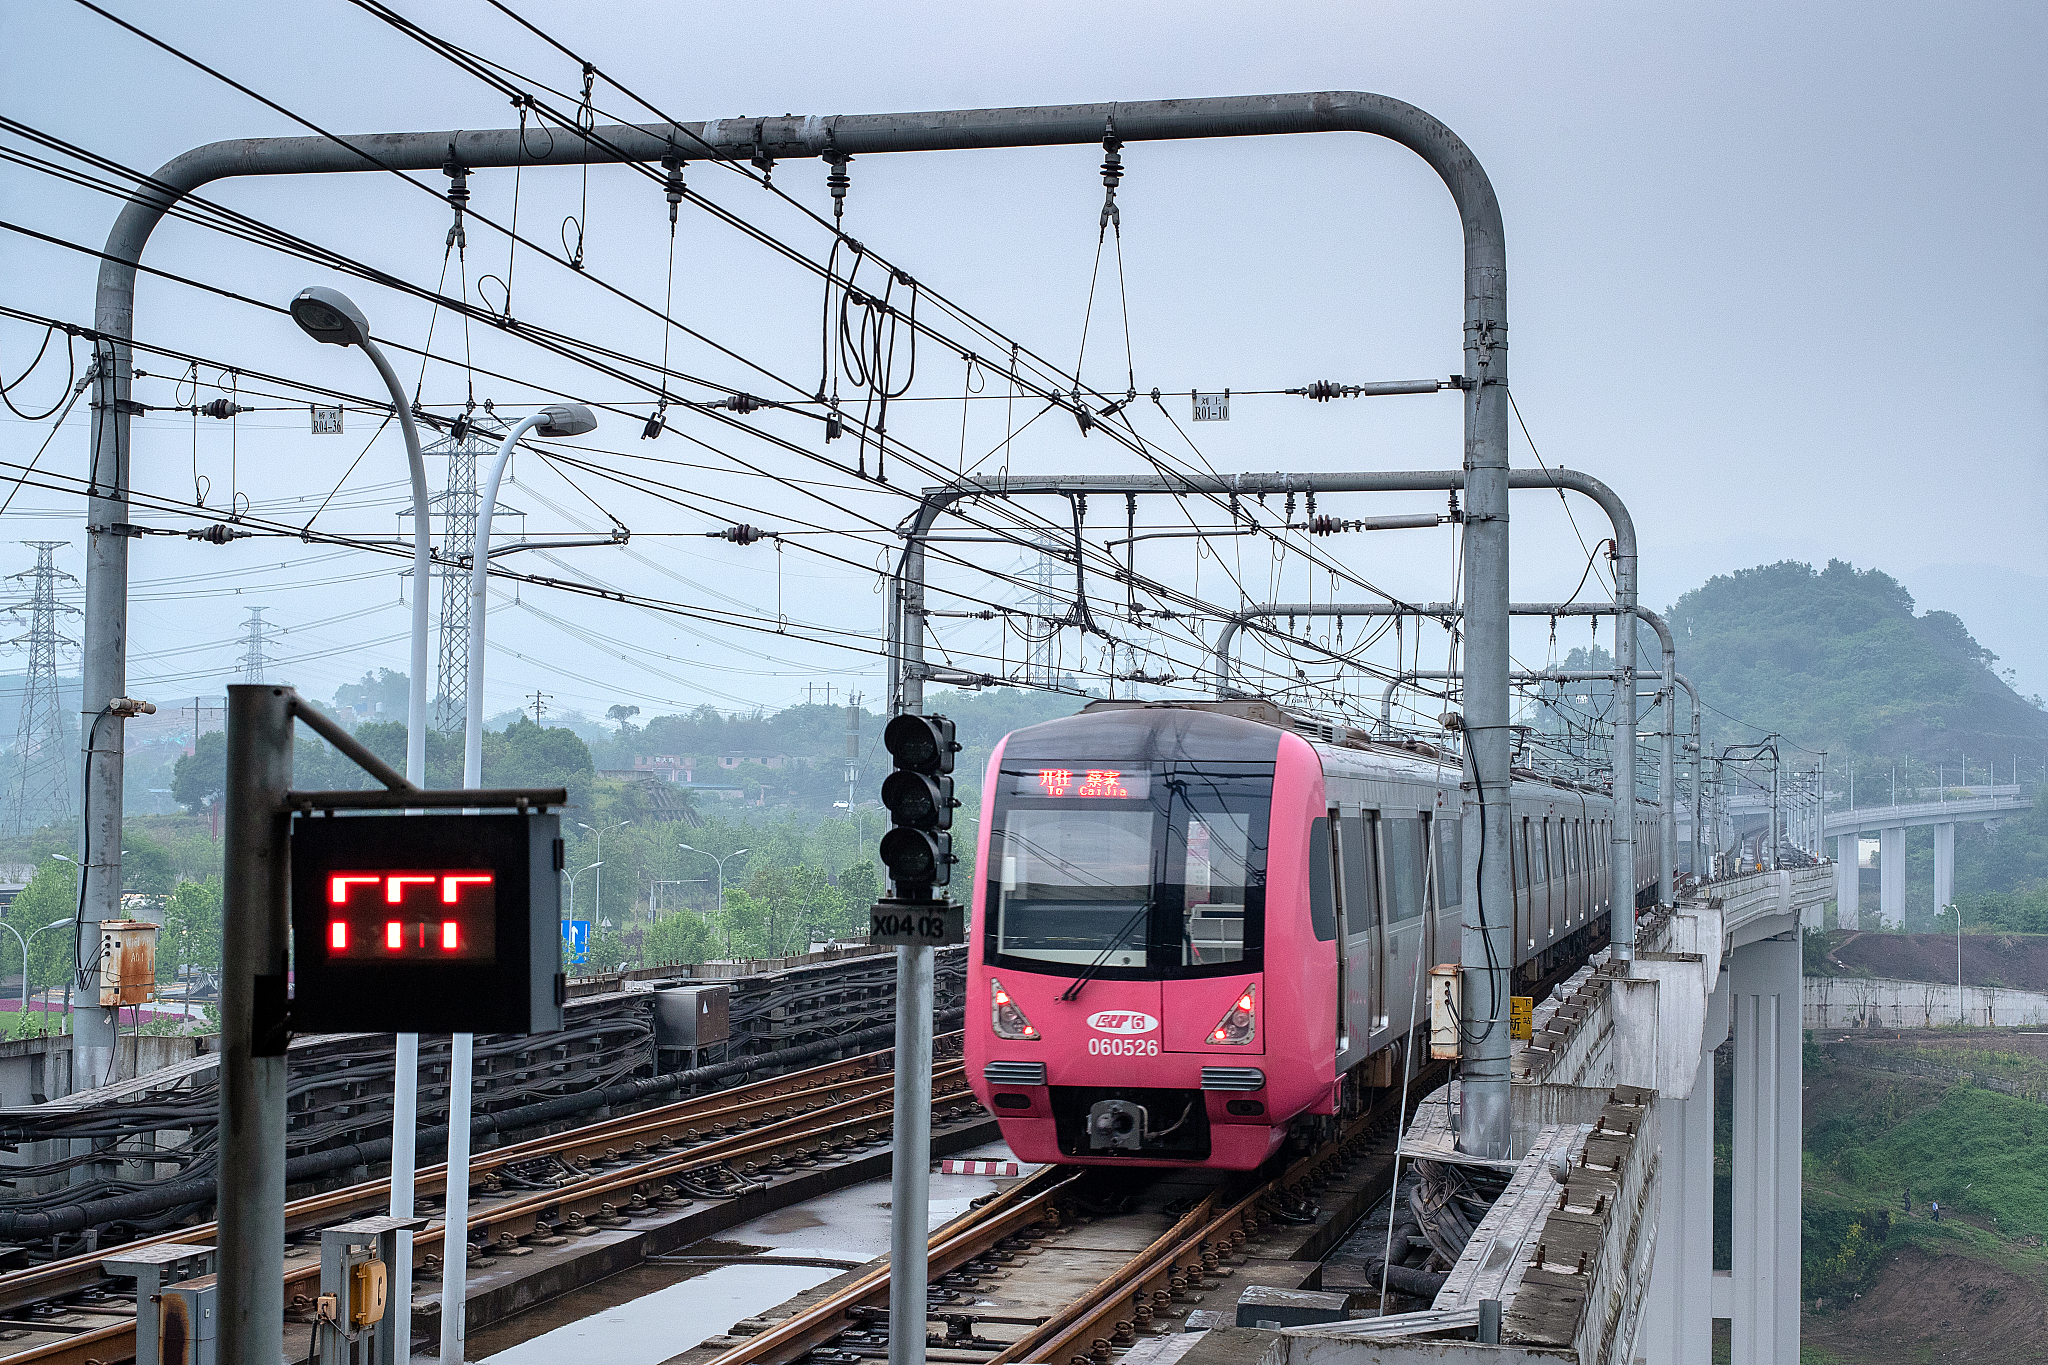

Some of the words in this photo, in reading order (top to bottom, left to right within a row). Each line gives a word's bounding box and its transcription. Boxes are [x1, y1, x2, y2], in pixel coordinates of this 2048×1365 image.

[1195, 406, 1228, 420] R01-10
[313, 420, 342, 433] R04-36
[1039, 769, 1072, 787] 开往
[1086, 770, 1121, 787] 蔡家
[1047, 785, 1064, 796] To
[1522, 998, 1532, 1025] 下一站
[1088, 1038, 1159, 1057] 060526
